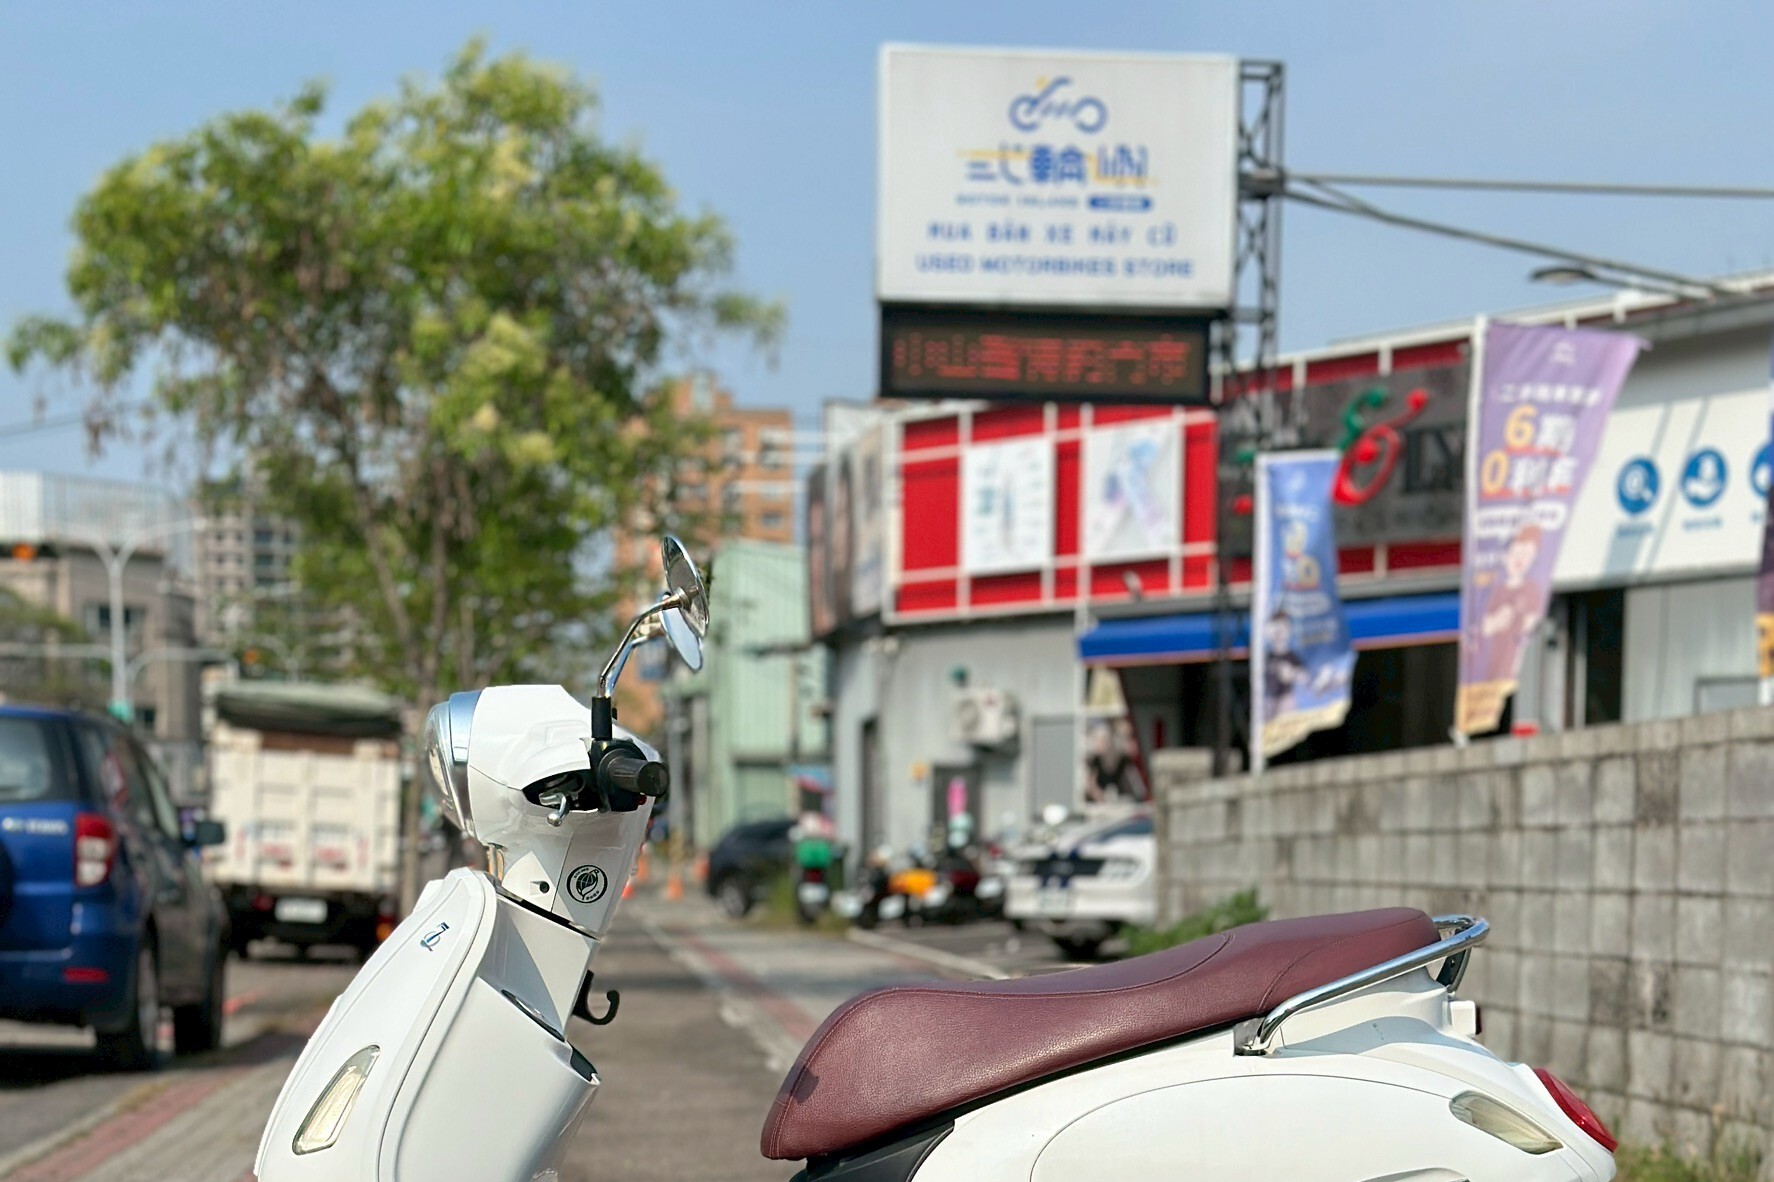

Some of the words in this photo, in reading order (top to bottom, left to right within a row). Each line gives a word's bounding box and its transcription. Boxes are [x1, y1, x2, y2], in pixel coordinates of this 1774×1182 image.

[916, 254, 974, 273] USED
[980, 255, 1116, 277] MOTORBIKES
[1122, 257, 1196, 278] STORE
